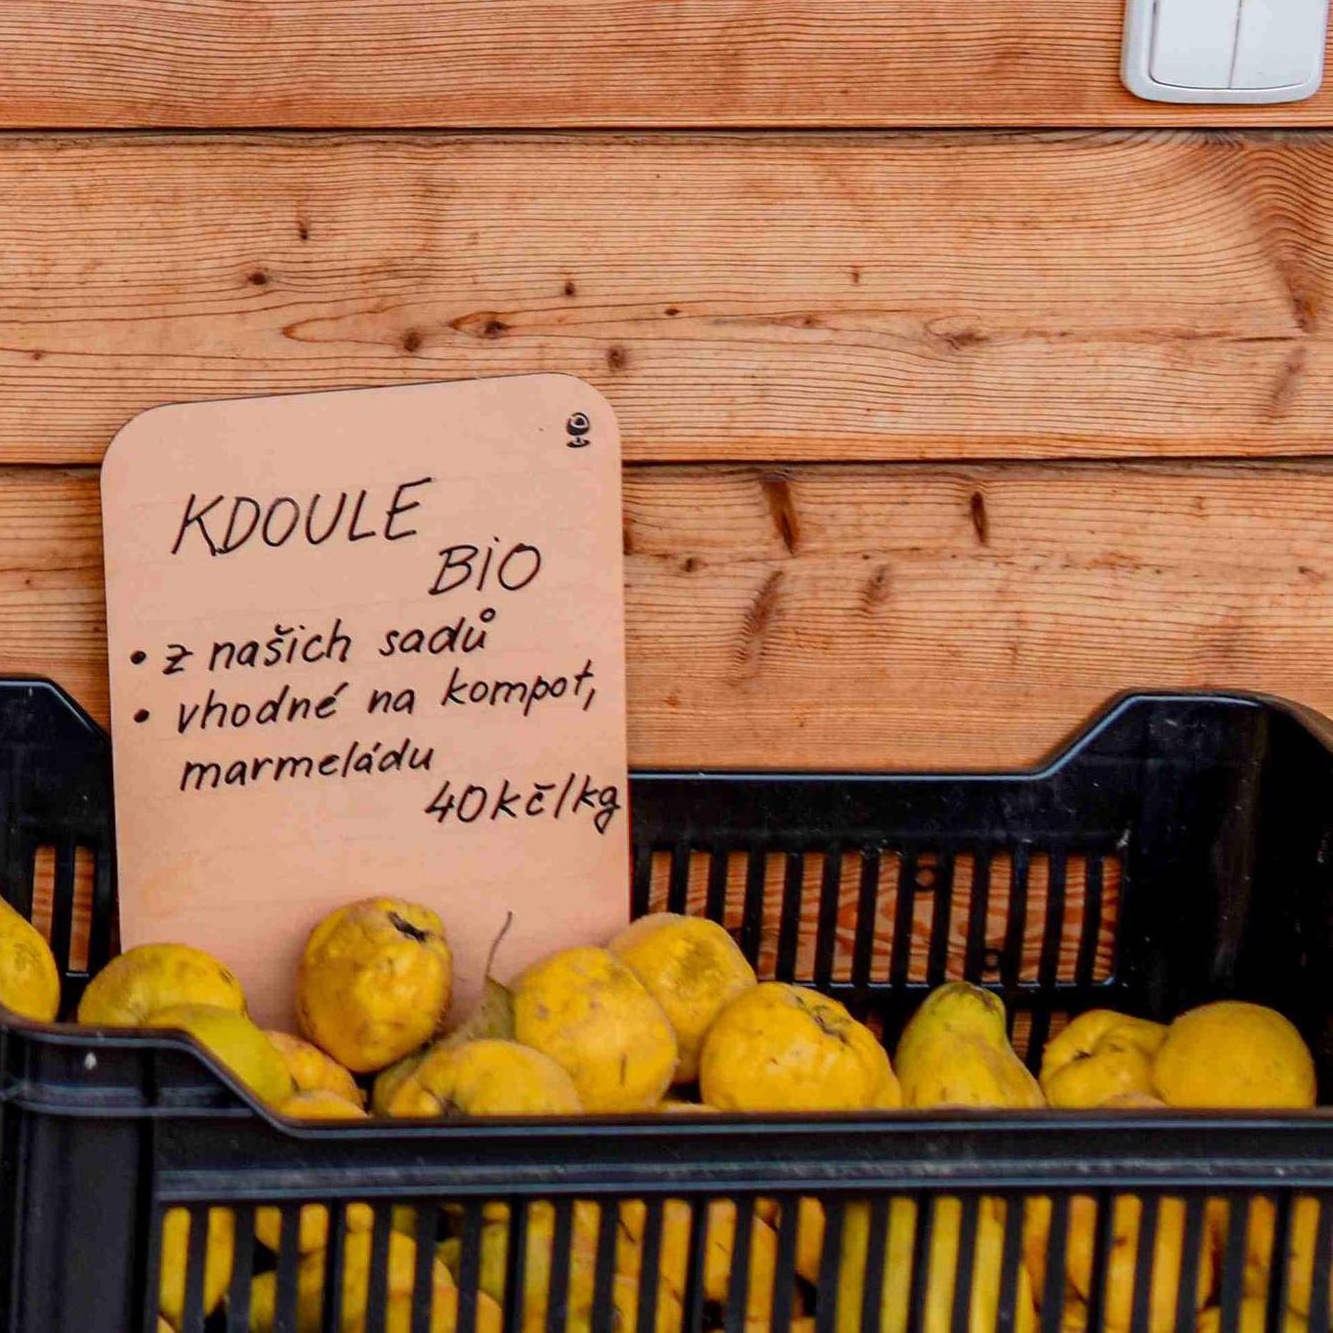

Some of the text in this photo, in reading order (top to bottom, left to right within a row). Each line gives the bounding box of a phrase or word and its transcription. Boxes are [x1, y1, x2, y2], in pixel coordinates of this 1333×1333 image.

[171, 476, 432, 557] KDOULE
[208, 618, 352, 671] našich
[379, 608, 497, 657] sadů
[178, 658, 598, 734] vhodné na kompot,
[180, 738, 434, 792] marmeládu
